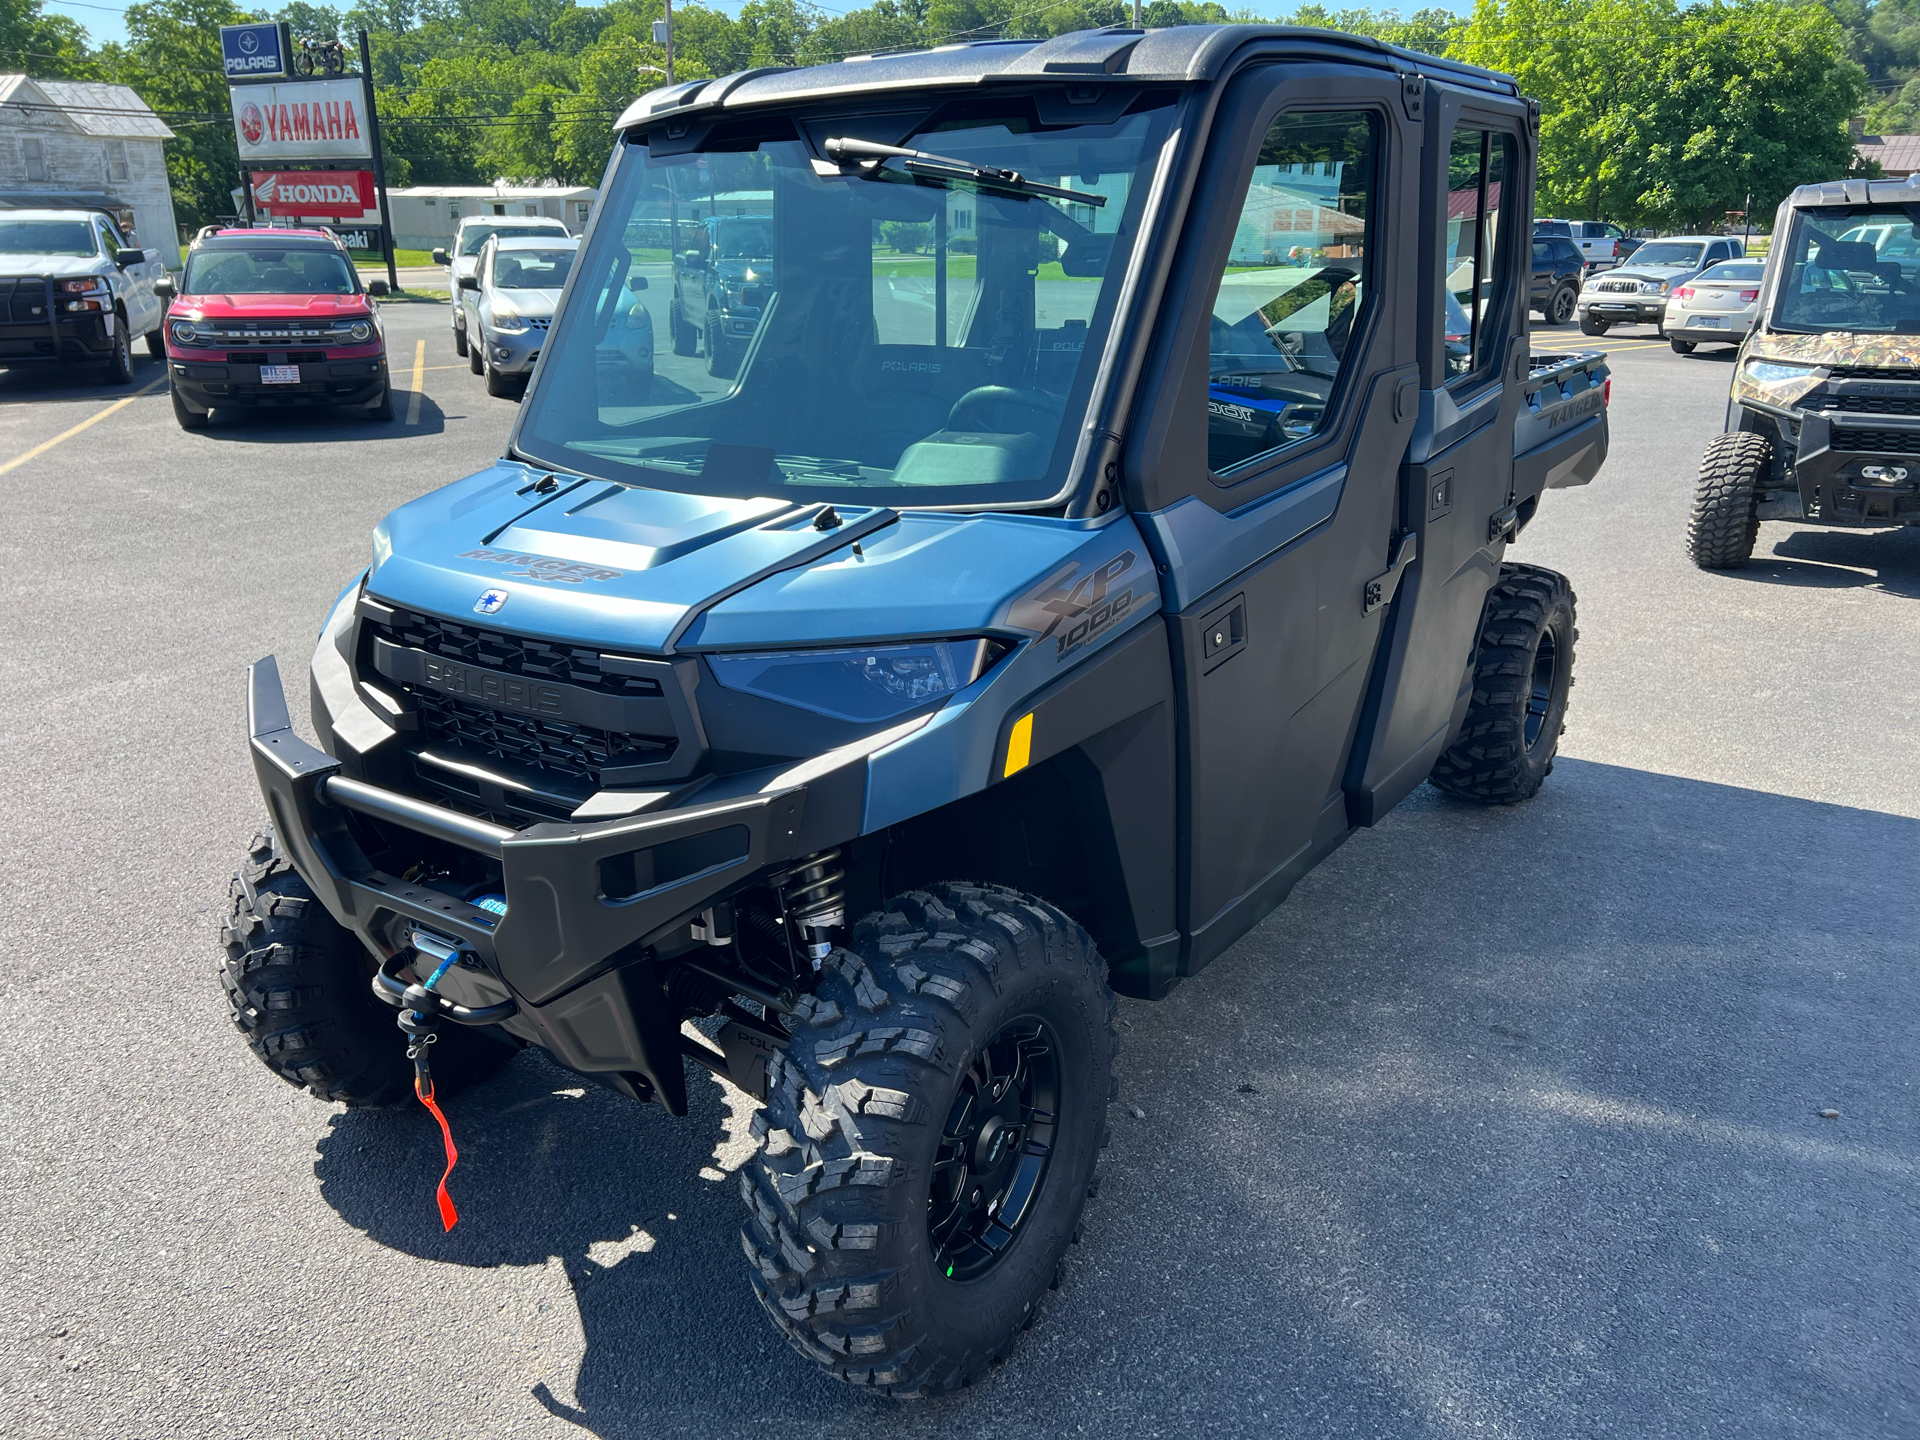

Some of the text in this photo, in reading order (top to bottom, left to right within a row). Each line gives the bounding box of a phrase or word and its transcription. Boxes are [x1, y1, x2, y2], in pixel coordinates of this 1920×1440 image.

[226, 55, 277, 71] POLARIS
[263, 101, 360, 142] YAMAHA
[277, 184, 360, 203] HONDA
[340, 230, 369, 248] saki
[881, 361, 942, 373] POLARIS
[1548, 390, 1602, 430] RANGER
[455, 550, 623, 582] RANGER
[502, 567, 585, 584] XP
[1028, 549, 1137, 650] XP
[1057, 589, 1133, 655] 1000
[424, 657, 565, 715] POLARIS
